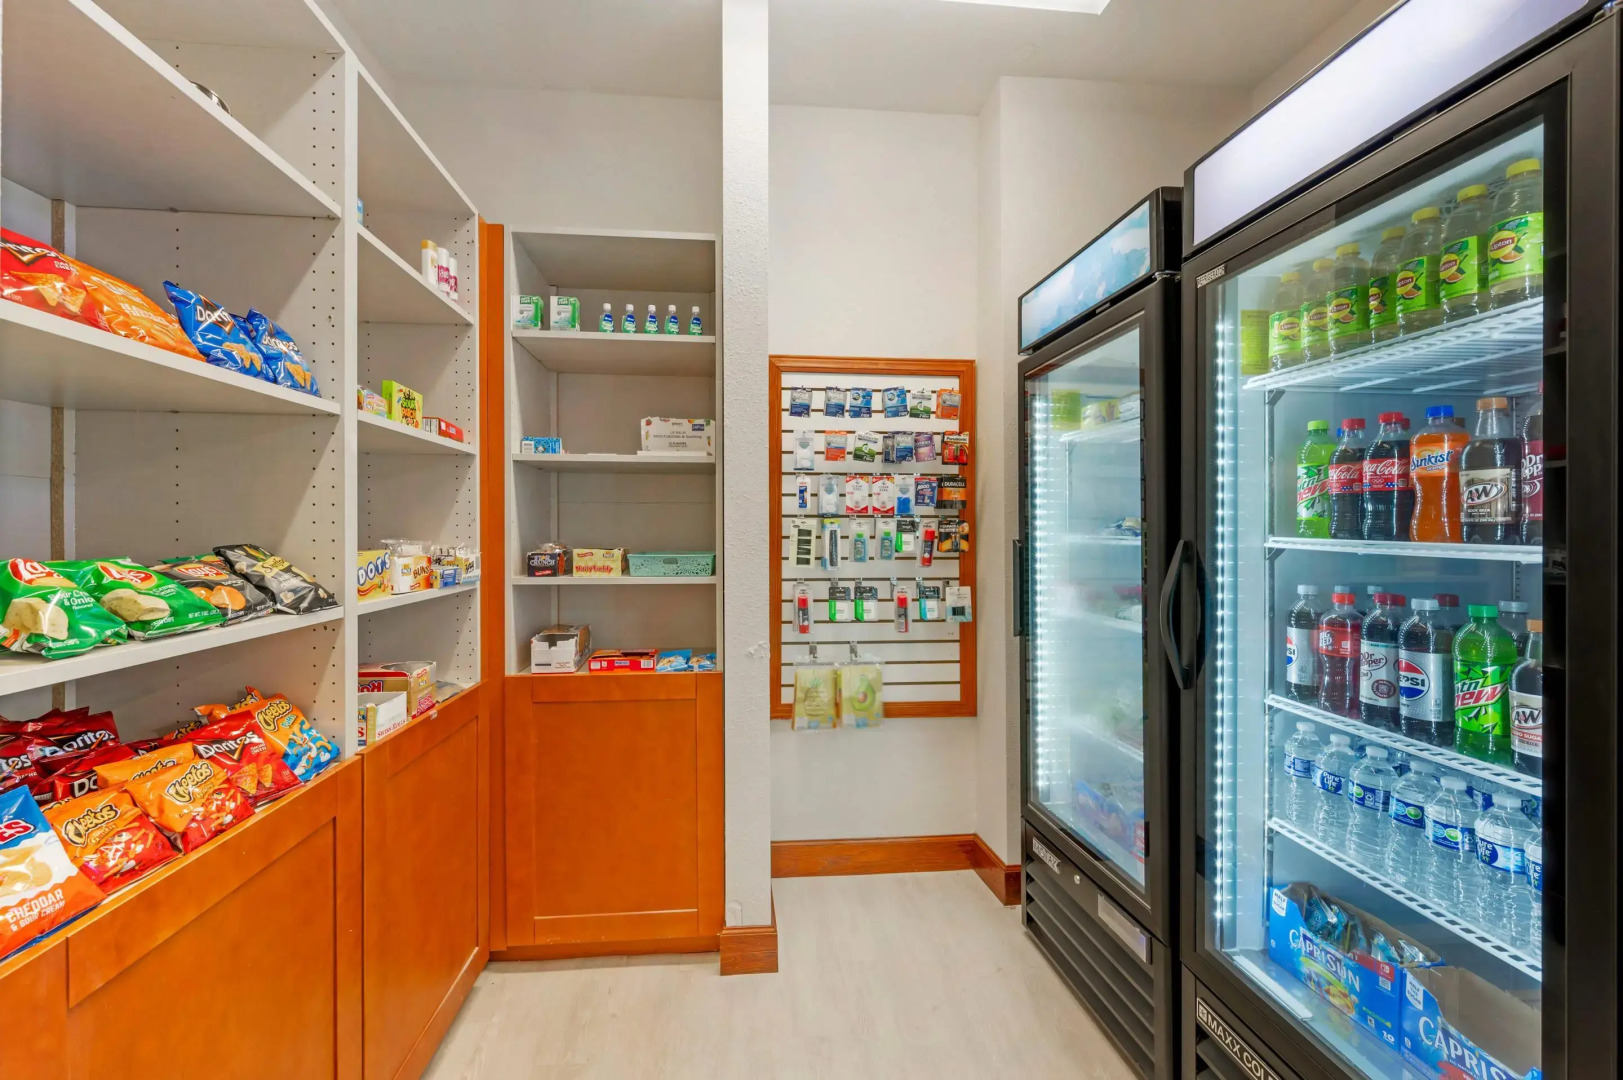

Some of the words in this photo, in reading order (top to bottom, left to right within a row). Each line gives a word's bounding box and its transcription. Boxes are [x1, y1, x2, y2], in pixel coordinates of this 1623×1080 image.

[1491, 237, 1513, 251] Lipton
[1410, 450, 1453, 472] Sunkist
[1466, 484, 1494, 502] A&W
[357, 551, 391, 587] DOTS
[413, 564, 430, 579] BUNS
[529, 559, 556, 568] CRUNCH
[1398, 675, 1425, 687] EPSI
[257, 700, 292, 731] Cheetos
[199, 731, 261, 758] Doritos
[167, 762, 212, 803] Cheetos
[1323, 771, 1340, 783] Pure
[1324, 778, 1338, 788] Life
[62, 804, 119, 846] Cheetos
[6, 888, 64, 923] CHEDDAR
[19, 913, 39, 928] SOUR
[41, 901, 66, 918] CREAM
[1207, 1014, 1240, 1058] MAXX
[1243, 1052, 1274, 1080] COL
[1382, 1030, 1394, 1042] 10
